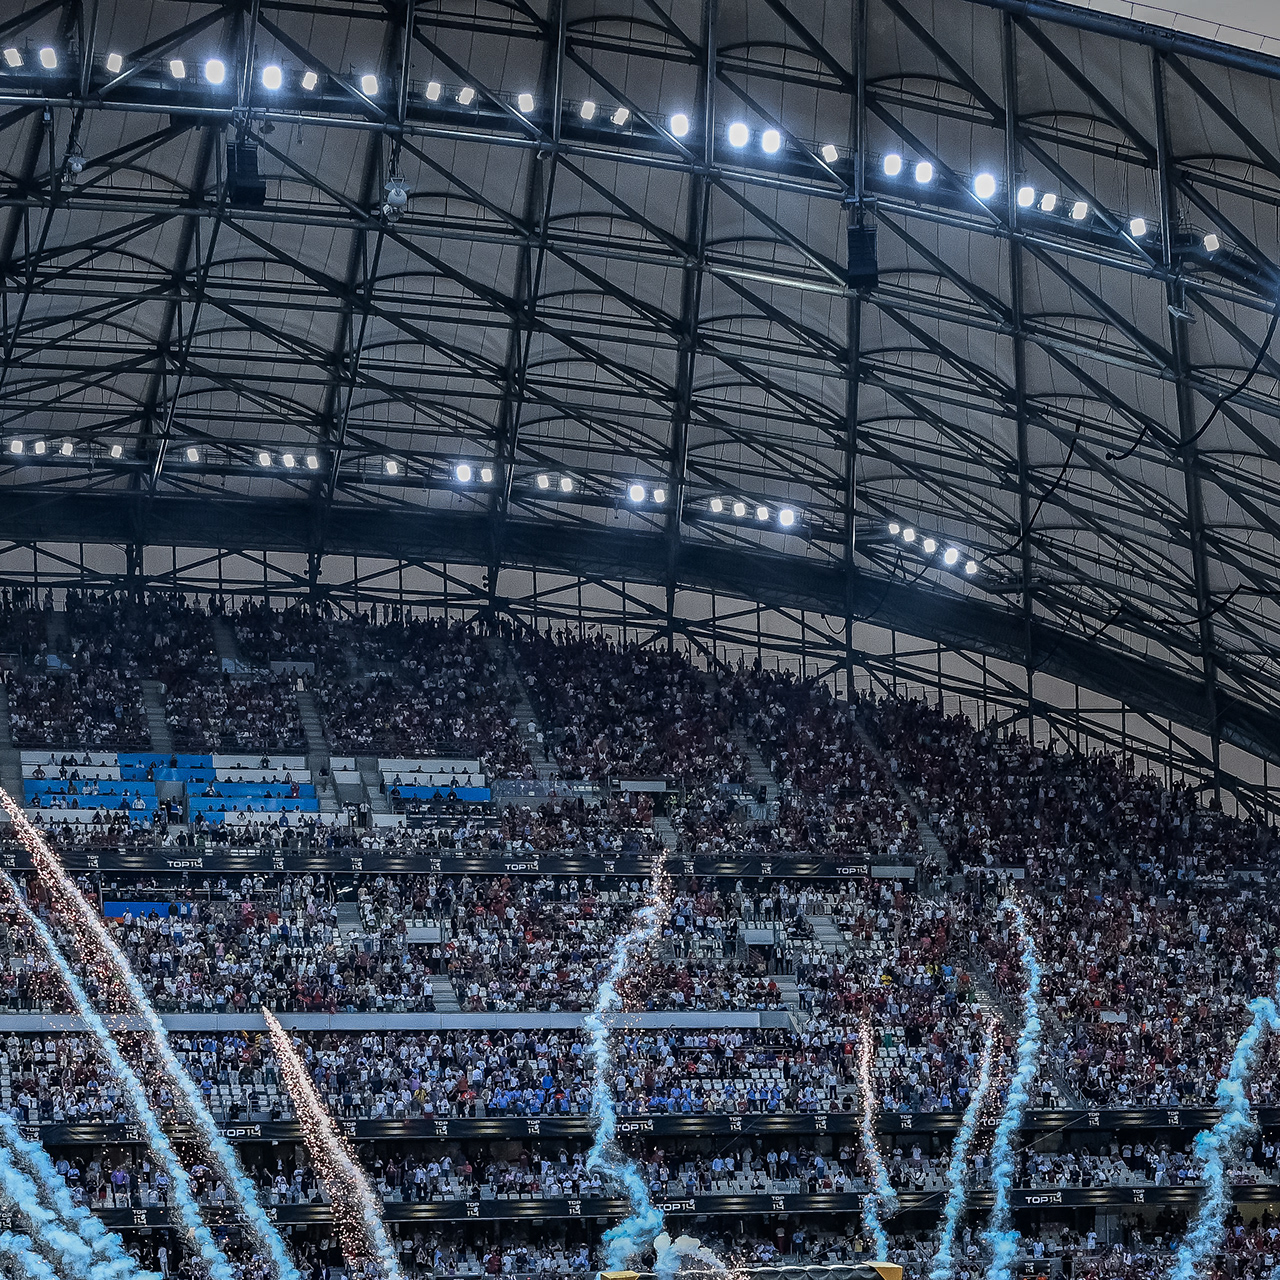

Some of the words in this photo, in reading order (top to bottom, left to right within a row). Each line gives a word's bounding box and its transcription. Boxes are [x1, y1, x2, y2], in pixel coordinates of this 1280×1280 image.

[167, 858, 203, 868] TOP14
[505, 862, 539, 872] TOP14
[836, 865, 868, 875] TOP14
[1025, 1193, 1062, 1204] TOP14
[656, 1200, 696, 1212] TOP14
